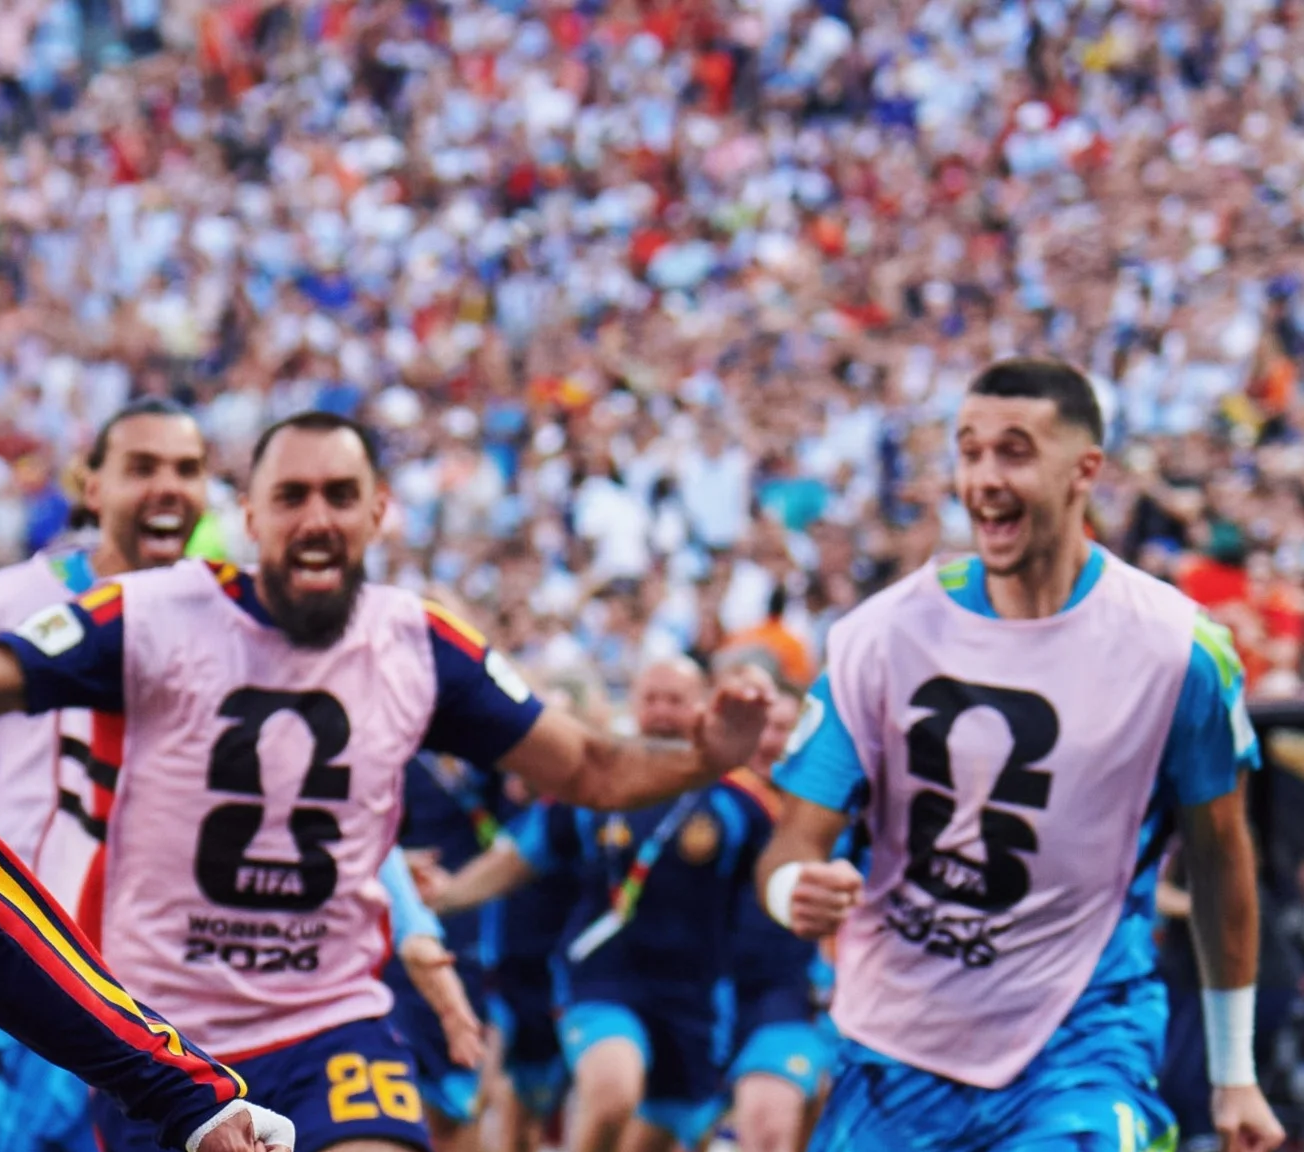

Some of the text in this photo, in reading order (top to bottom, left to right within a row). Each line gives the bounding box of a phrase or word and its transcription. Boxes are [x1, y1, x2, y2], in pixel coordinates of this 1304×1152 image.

[235, 866, 304, 897] FIFA
[183, 937, 321, 973] 2026
[325, 1052, 423, 1124] 26
